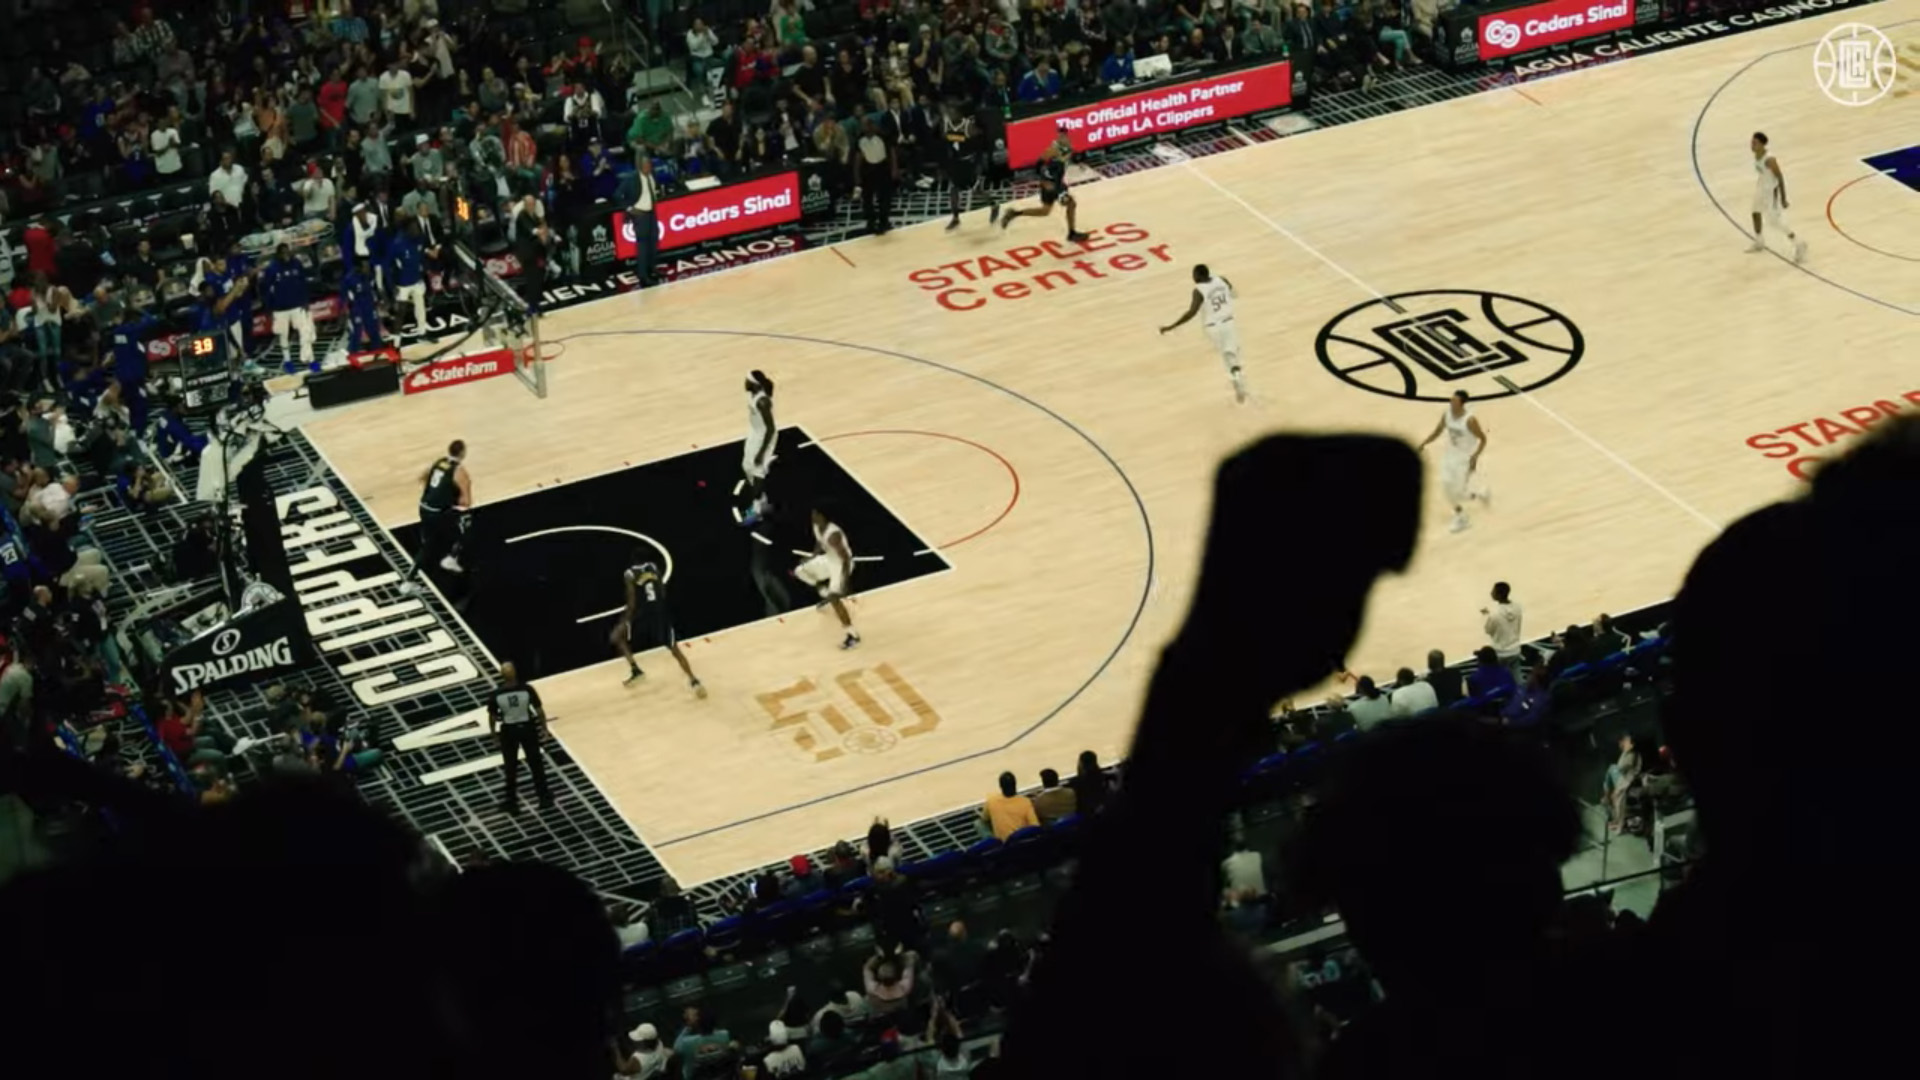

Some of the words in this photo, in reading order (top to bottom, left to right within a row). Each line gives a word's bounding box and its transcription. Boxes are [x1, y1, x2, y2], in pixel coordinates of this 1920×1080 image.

[1514, 52, 1594, 77] AGUA
[1594, 20, 1729, 57] CALIENTE
[1728, 0, 1849, 26] CASINO
[1525, 13, 1584, 36] Cedars
[1056, 117, 1083, 131] The
[1087, 103, 1138, 126] Official
[1141, 94, 1188, 113] Health
[1191, 80, 1245, 102] Partner
[1088, 129, 1104, 143] of
[1106, 124, 1129, 138] the
[1133, 118, 1153, 132] LA
[1156, 104, 1215, 127] Clippers
[669, 203, 740, 232] Cedars
[743, 188, 792, 216] Sinai
[908, 222, 1150, 291] STAPLES
[936, 243, 1173, 312] Center
[171, 635, 295, 696] SPALDING
